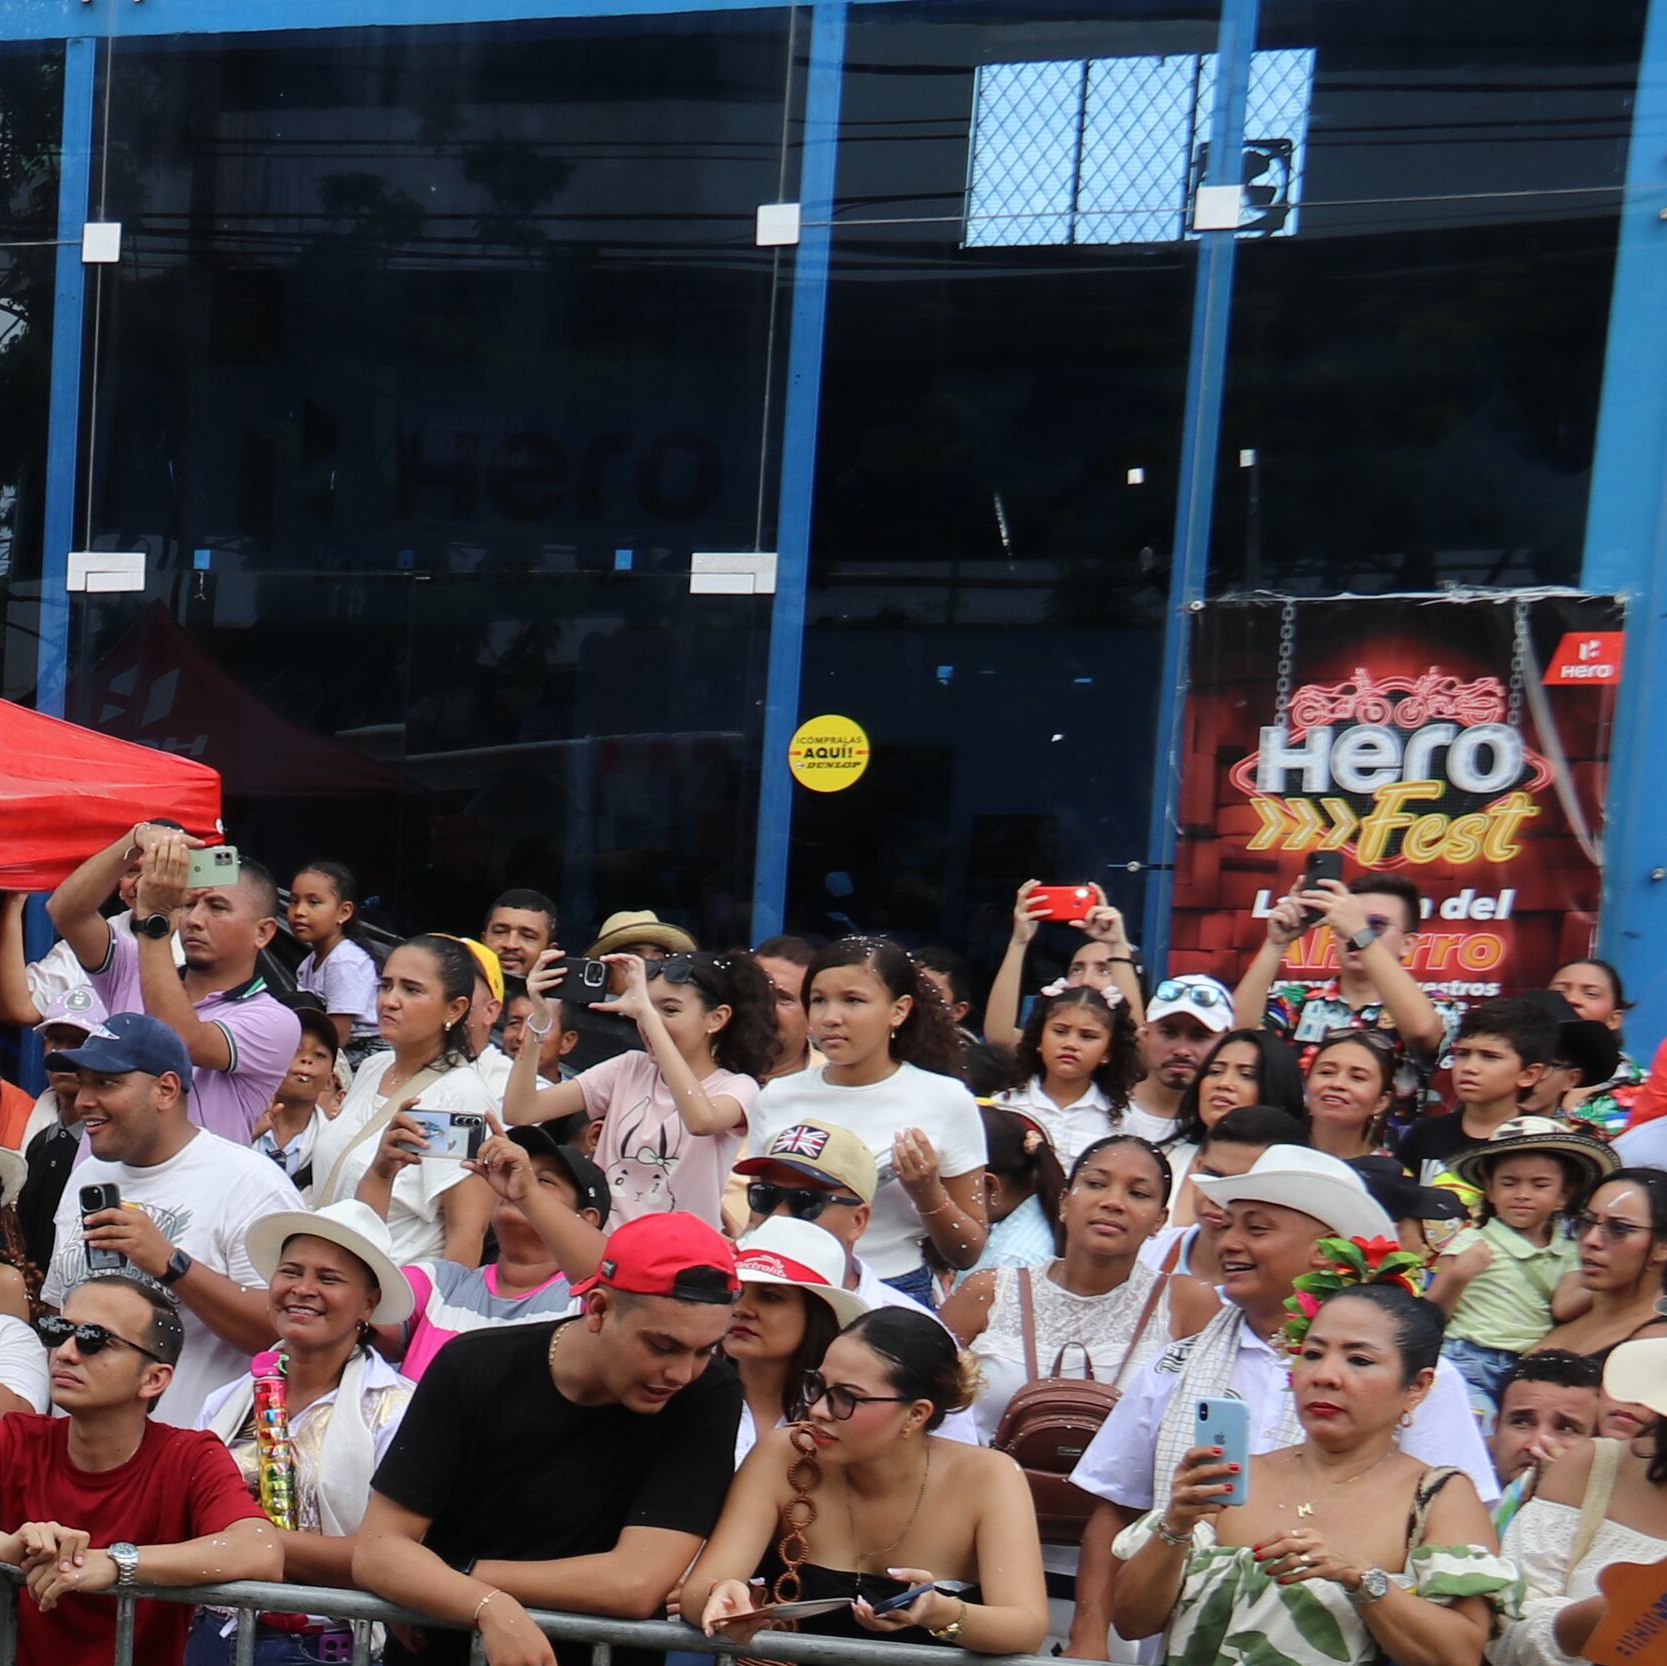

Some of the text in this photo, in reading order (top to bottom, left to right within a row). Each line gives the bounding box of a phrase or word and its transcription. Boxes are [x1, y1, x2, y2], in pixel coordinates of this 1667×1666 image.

[1560, 664, 1615, 679] Hero
[803, 744, 853, 759] AQUÍ!
[1256, 722, 1525, 794] Hero
[806, 761, 862, 769] DUNLOP
[1356, 780, 1542, 867] Fest
[1439, 888, 1517, 920] del
